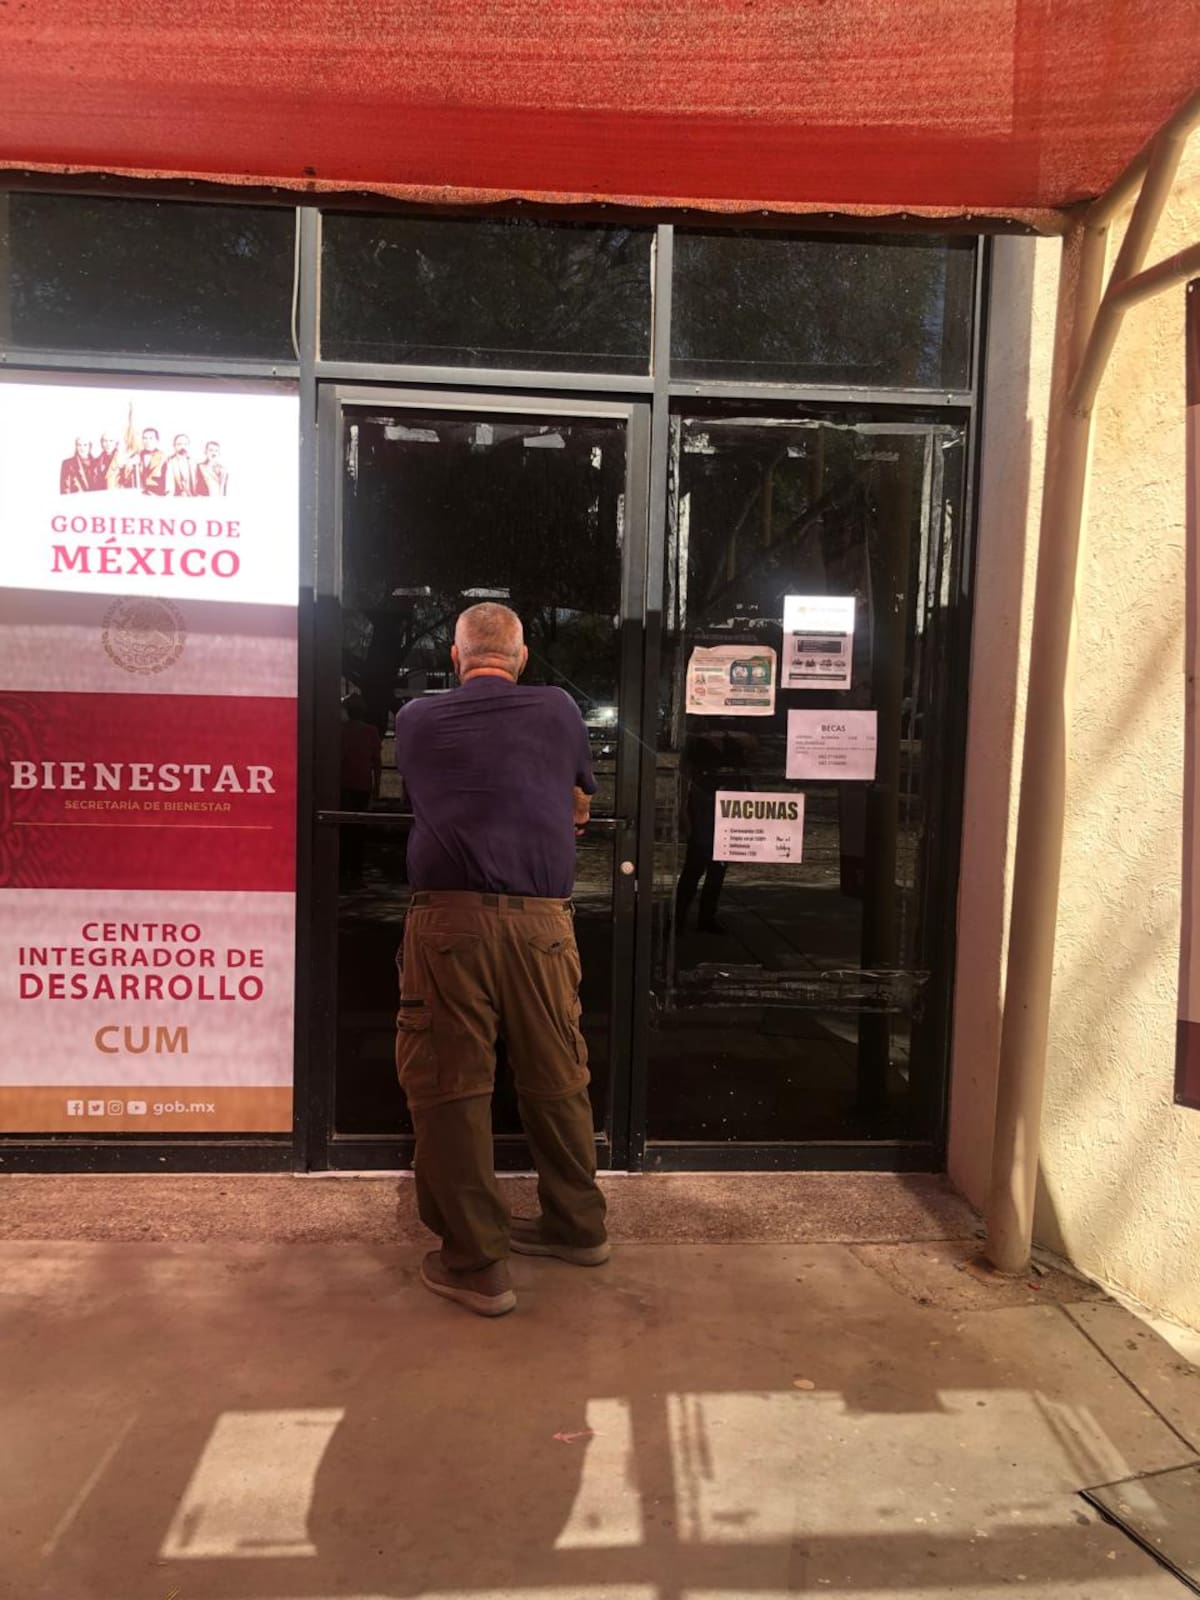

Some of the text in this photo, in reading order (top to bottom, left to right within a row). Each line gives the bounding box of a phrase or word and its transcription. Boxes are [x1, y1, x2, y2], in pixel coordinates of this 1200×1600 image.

[51, 515, 241, 538] GOBIERNO DE
[51, 537, 241, 578] MÉXICO
[821, 724, 846, 732] BECAS
[10, 760, 276, 794] BIENESTAR
[64, 799, 232, 812] SECRETARÍA DE BIENESTAR
[720, 799, 798, 820] VACUNAS
[82, 922, 201, 943] CENTRO
[18, 947, 264, 968] INTEGRADOR DE
[19, 973, 264, 1001] DESARROLLO
[94, 1025, 189, 1054] CUM
[153, 1100, 216, 1115] gob.mx
